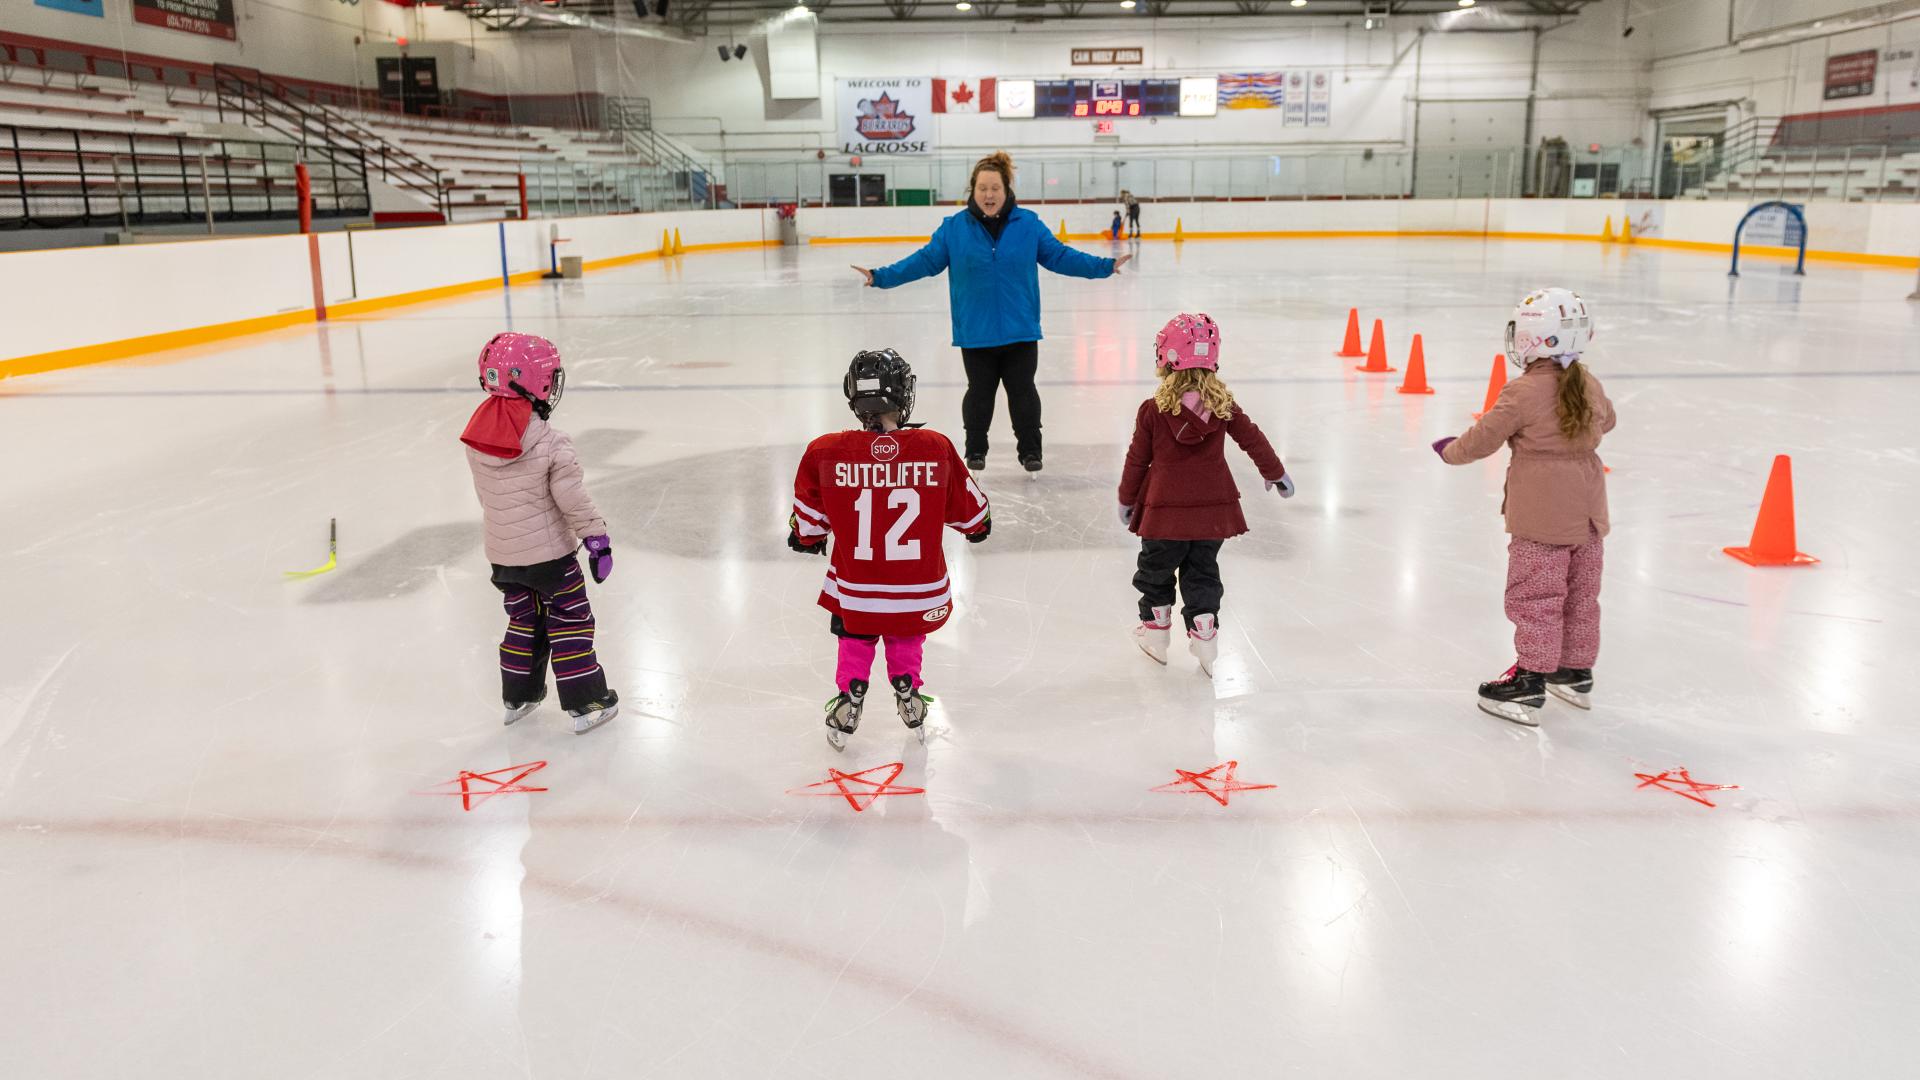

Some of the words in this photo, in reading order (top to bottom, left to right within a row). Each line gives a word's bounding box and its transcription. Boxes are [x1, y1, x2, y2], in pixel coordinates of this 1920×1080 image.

[1115, 50, 1140, 62] ARENA
[848, 80, 900, 88] WELCOME
[906, 80, 921, 88] TO
[1098, 121, 1113, 133] 30
[844, 141, 928, 154] LACROSSE
[874, 444, 896, 455] STOP
[835, 462, 938, 488] SUTCLIFFE
[854, 488, 921, 561] 12
